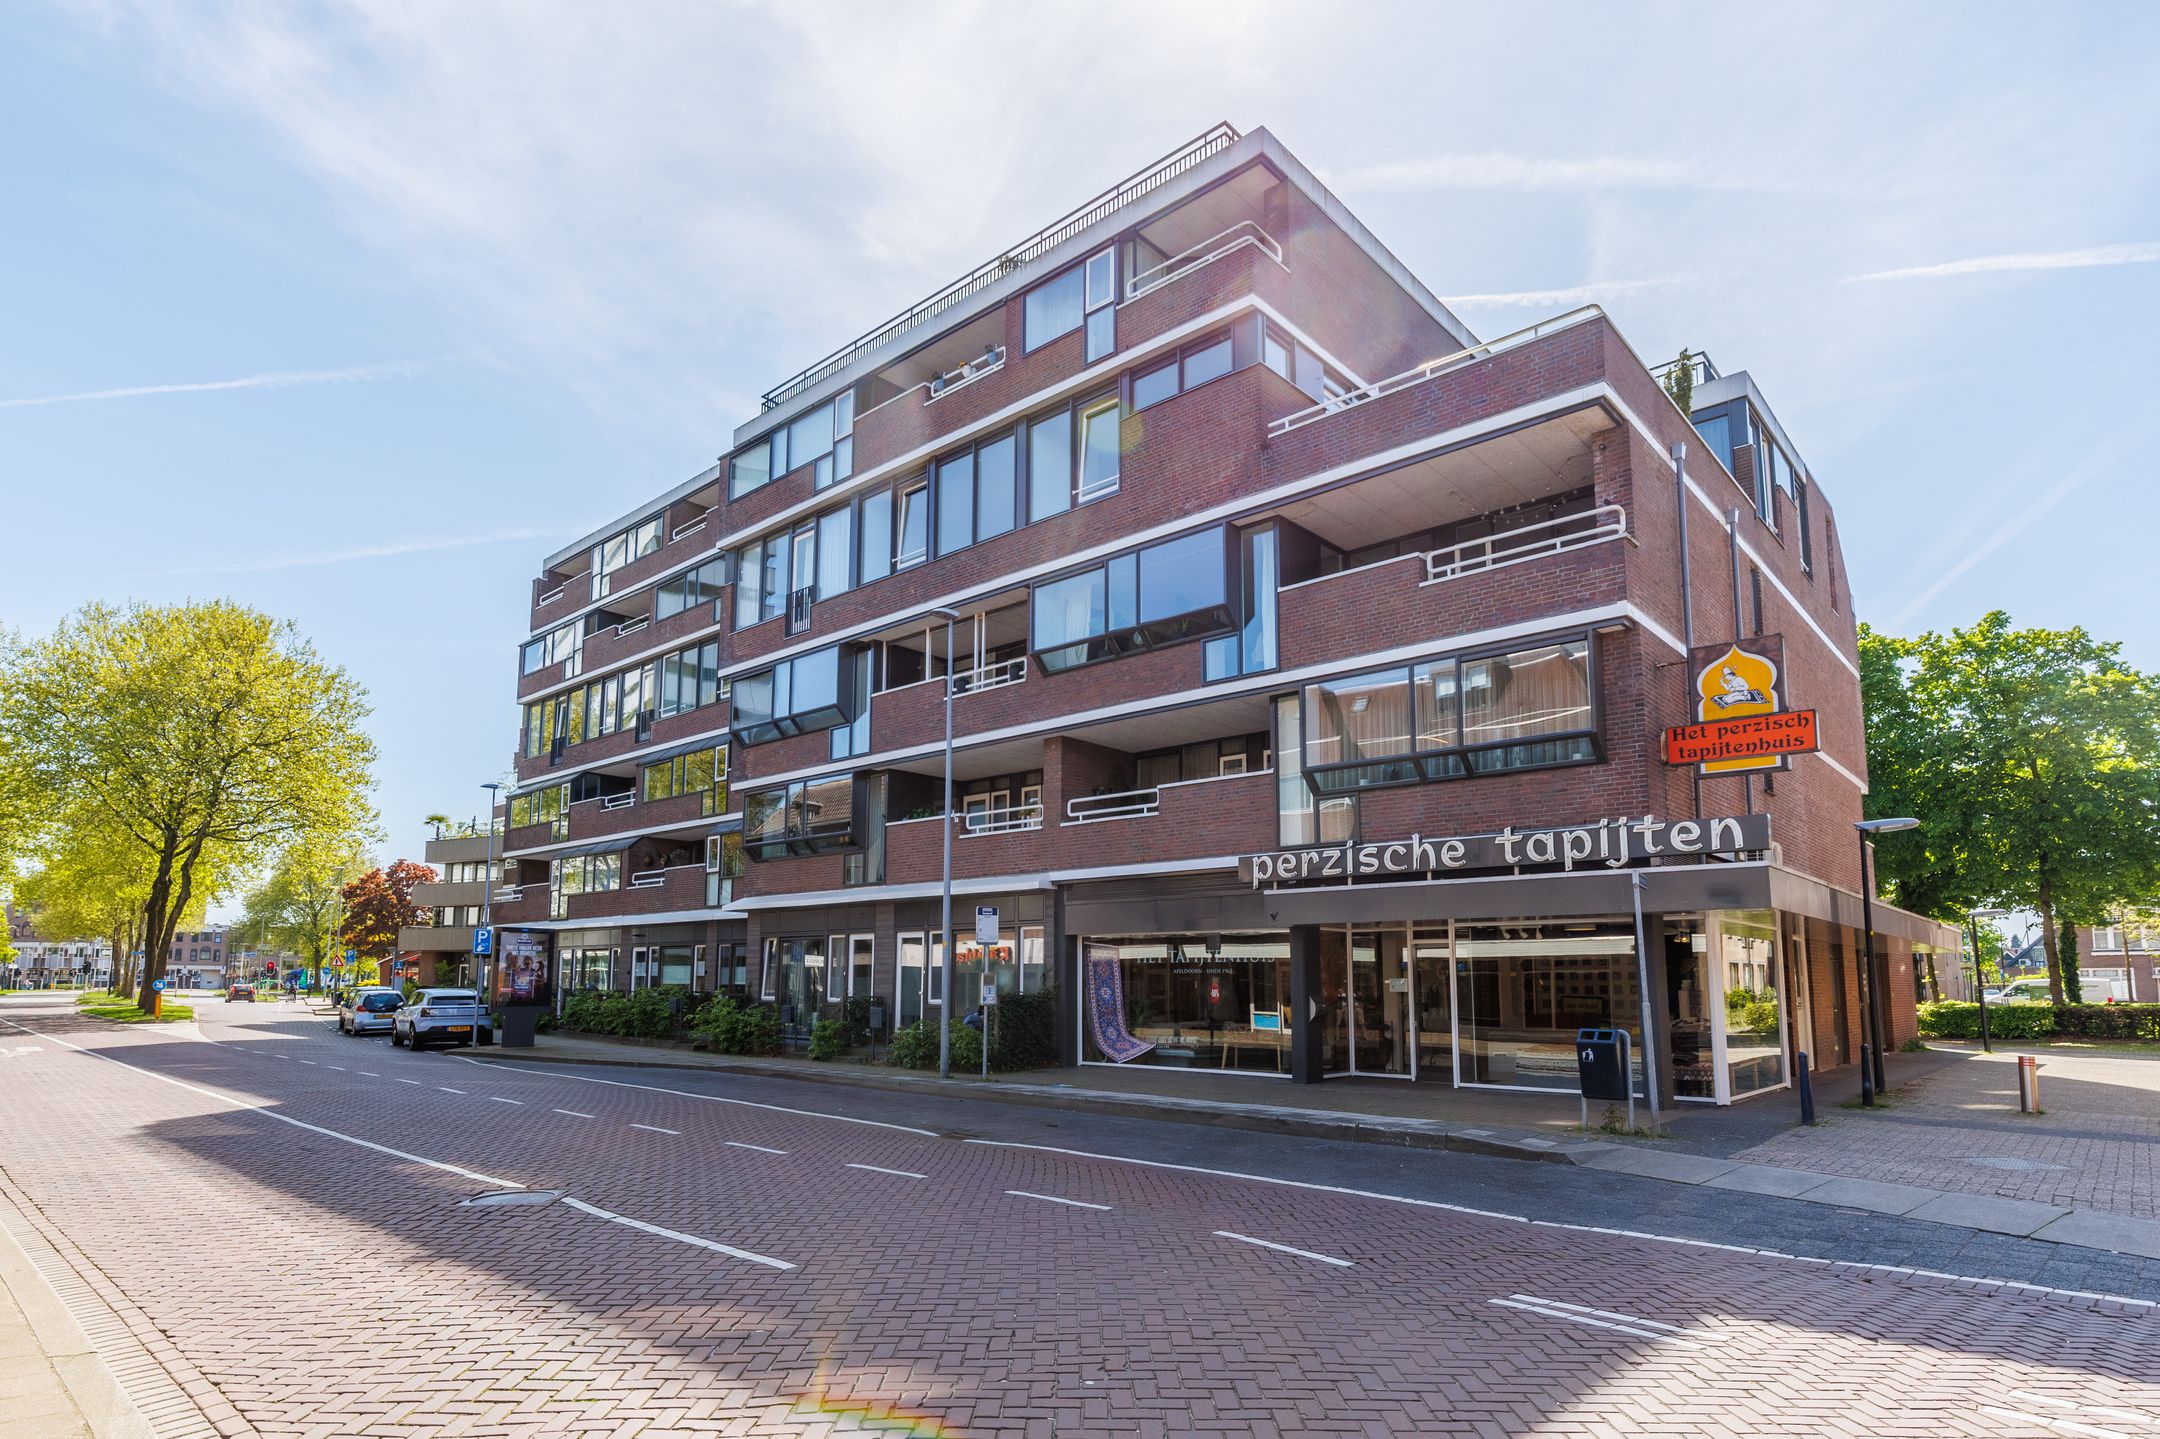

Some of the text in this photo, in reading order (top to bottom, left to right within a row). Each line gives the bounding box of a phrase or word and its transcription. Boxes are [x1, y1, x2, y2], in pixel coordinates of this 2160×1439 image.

[1672, 714, 1810, 742] Het perzisch
[1679, 734, 1805, 760] tapijtenhuis
[1252, 814, 1744, 890] perzische tapijten
[478, 930, 488, 943] P
